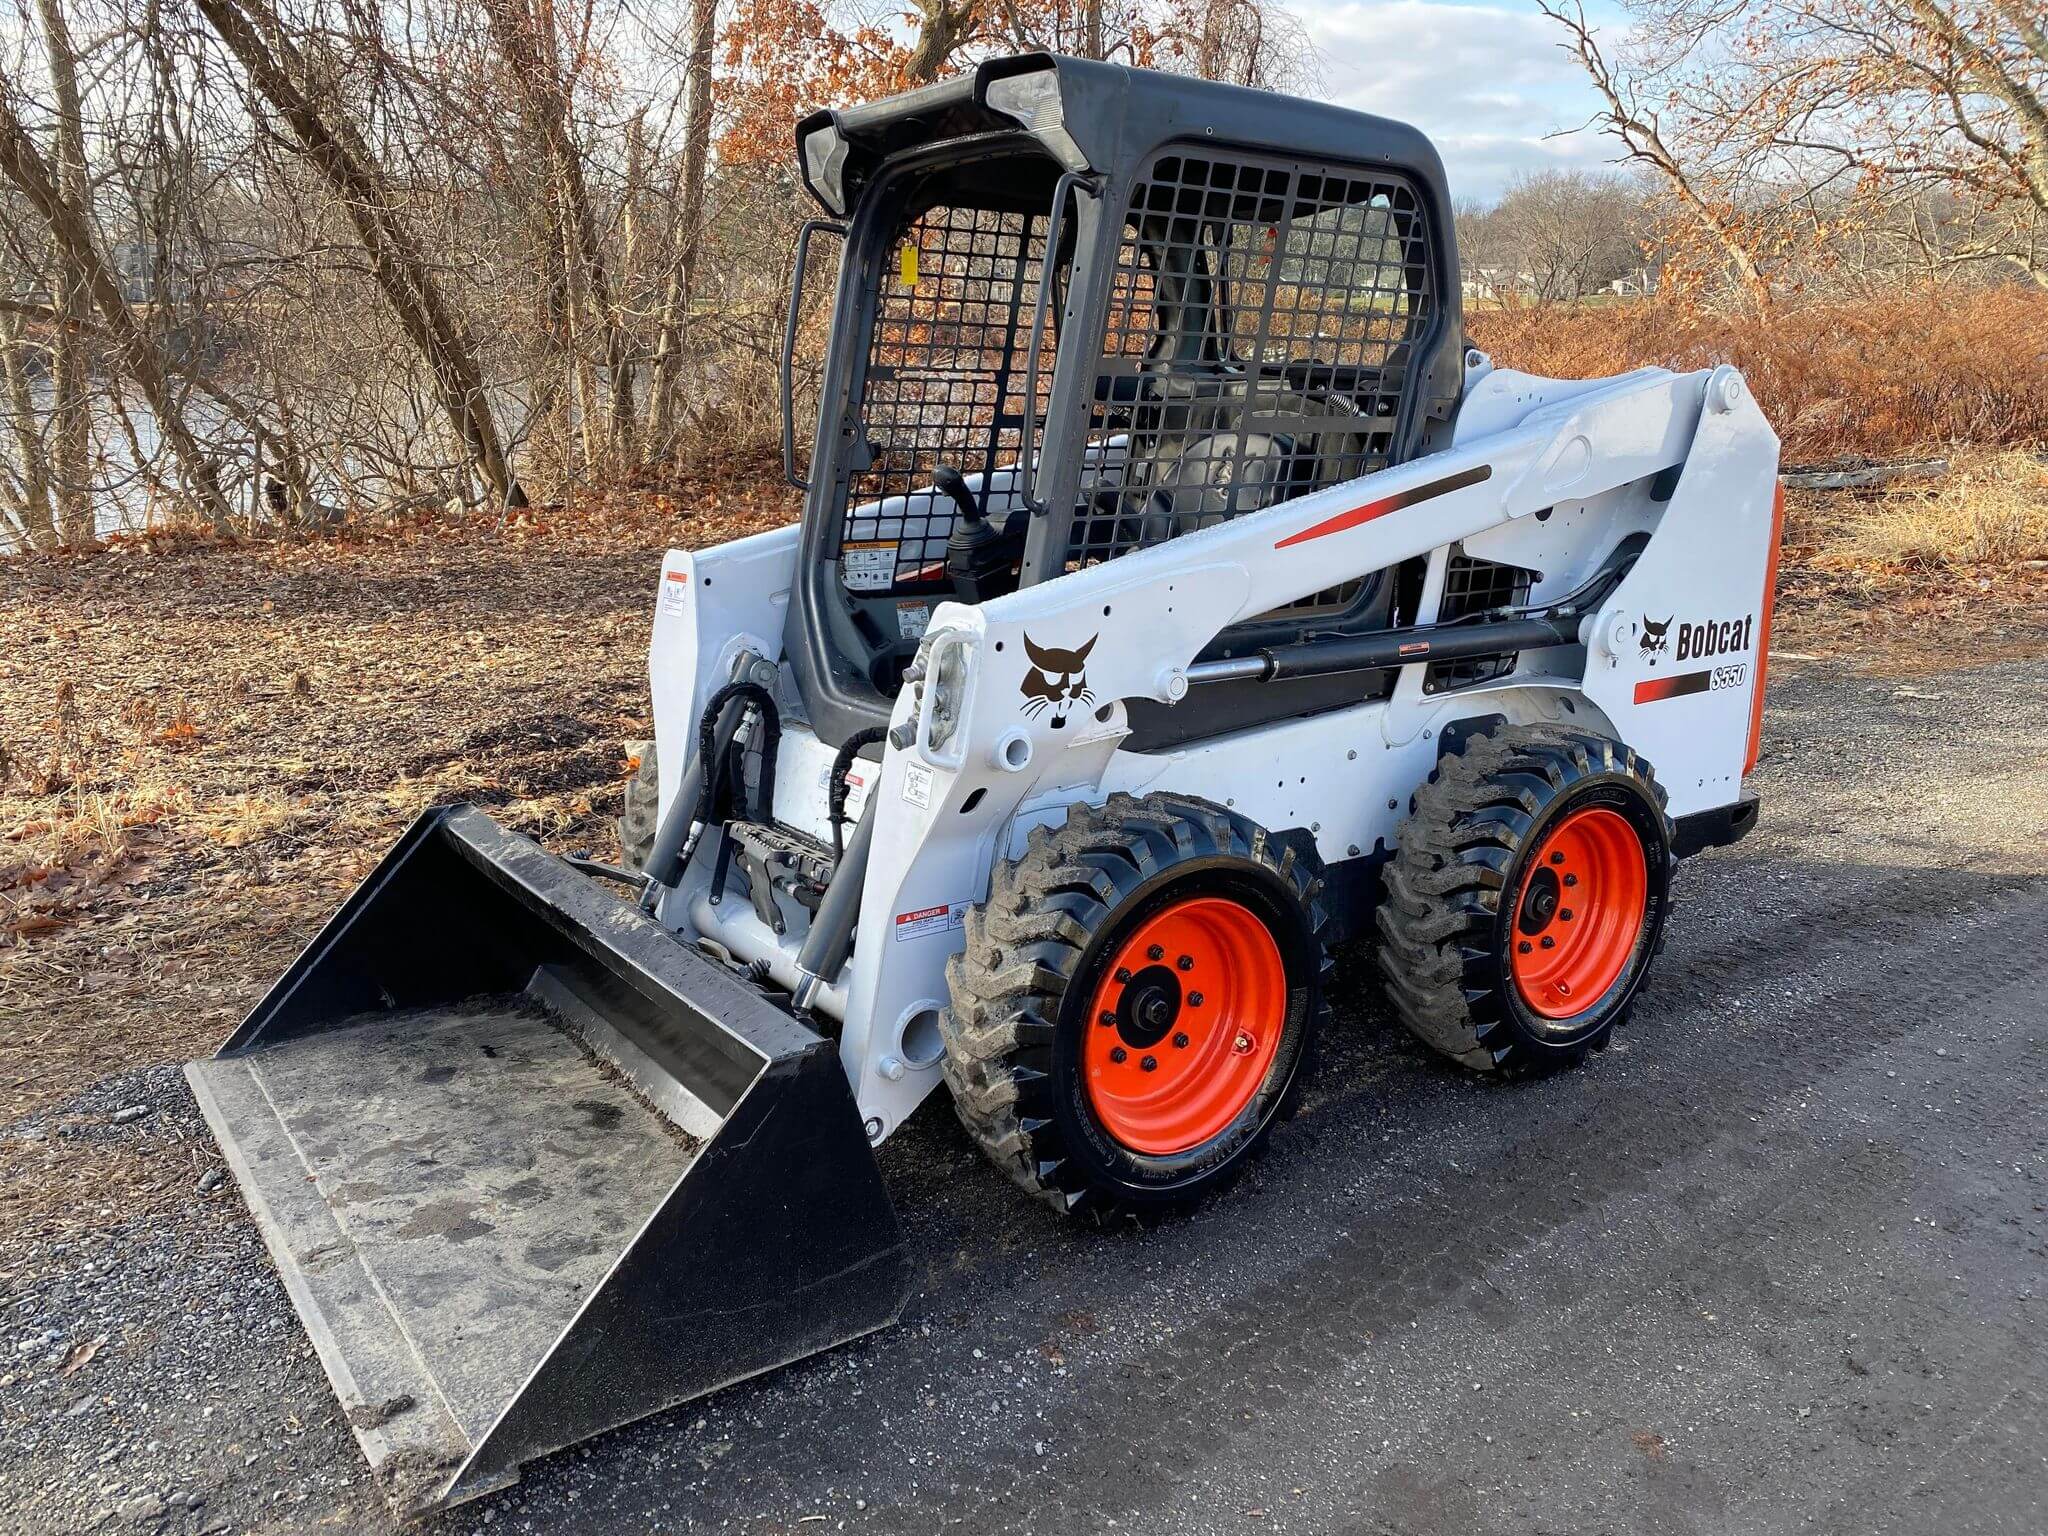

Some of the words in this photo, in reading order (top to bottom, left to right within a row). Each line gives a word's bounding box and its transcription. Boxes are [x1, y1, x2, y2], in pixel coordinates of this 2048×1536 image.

[1676, 613, 1752, 661] Bobcat
[1711, 663, 1747, 690] S550
[913, 908, 941, 920] DANGER
